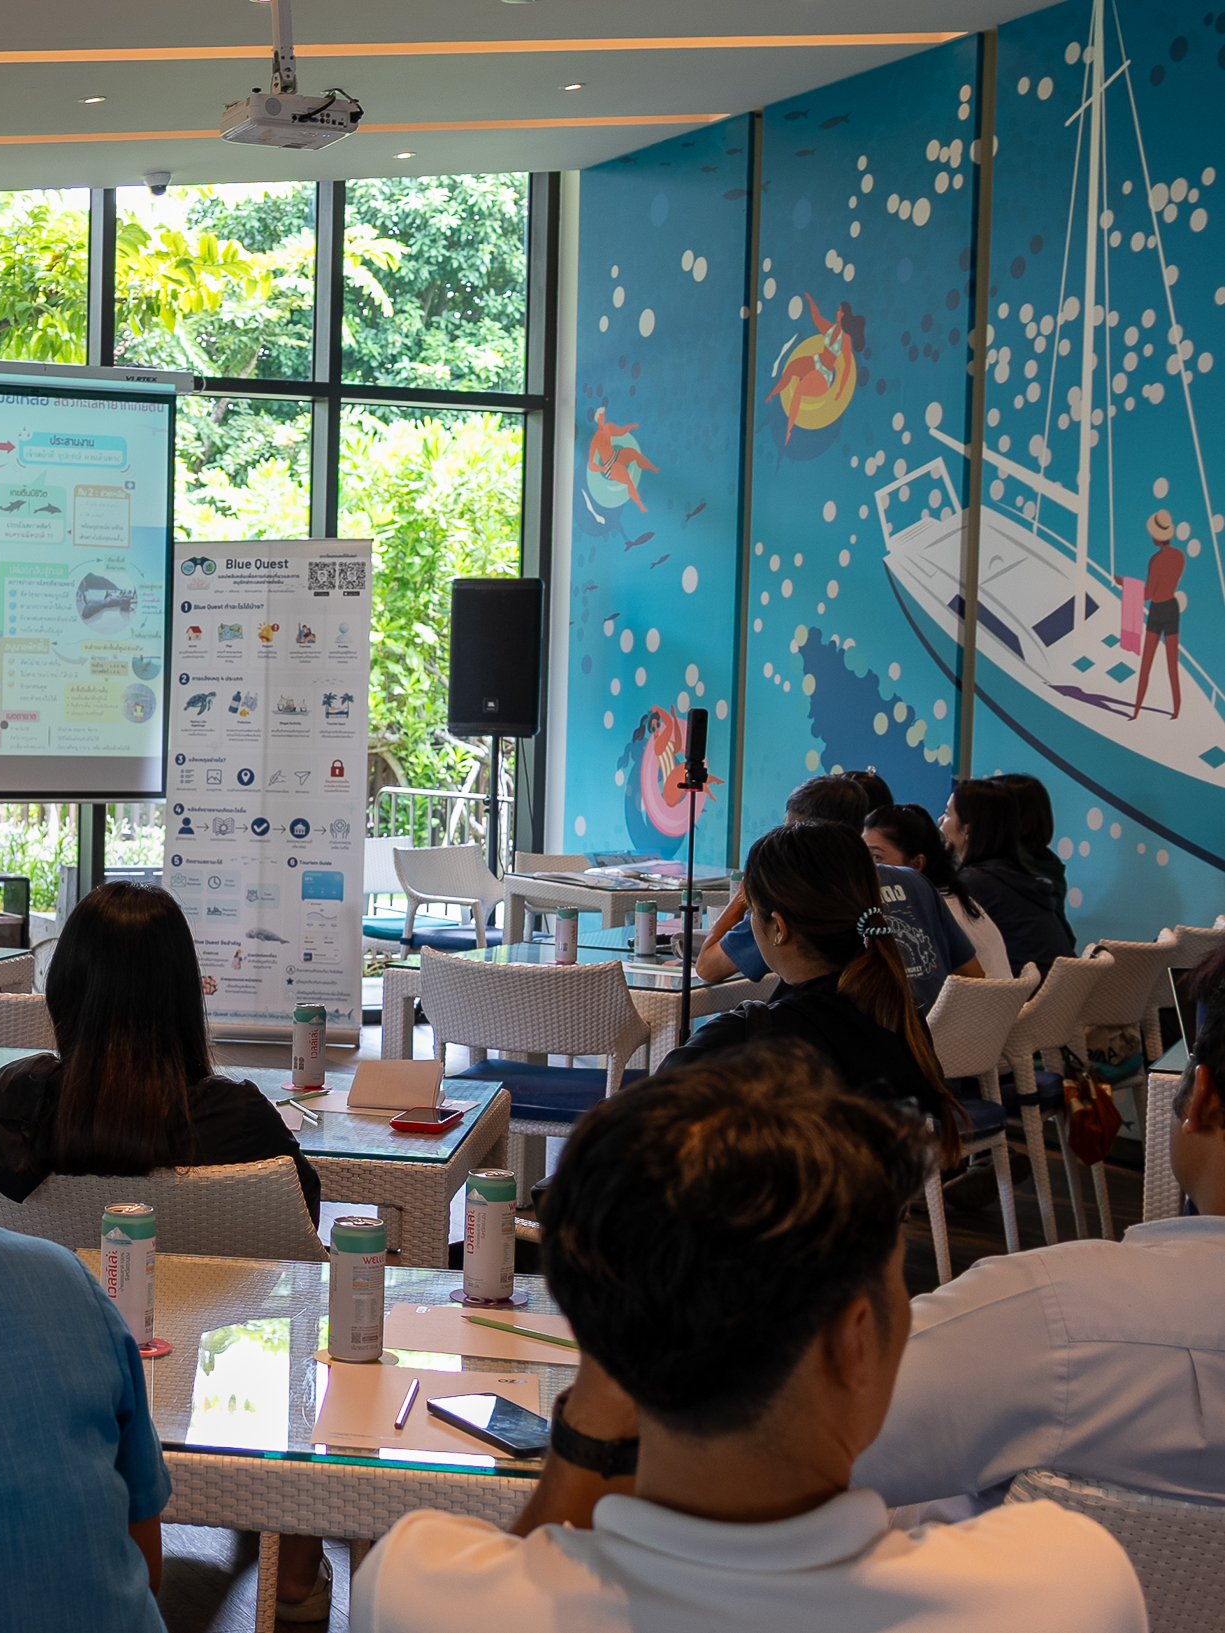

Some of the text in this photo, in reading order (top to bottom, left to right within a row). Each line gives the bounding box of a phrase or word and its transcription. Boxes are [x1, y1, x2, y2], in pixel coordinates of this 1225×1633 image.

[49, 434, 95, 448] ประสานงาน
[225, 558, 289, 571] Blue Quest
